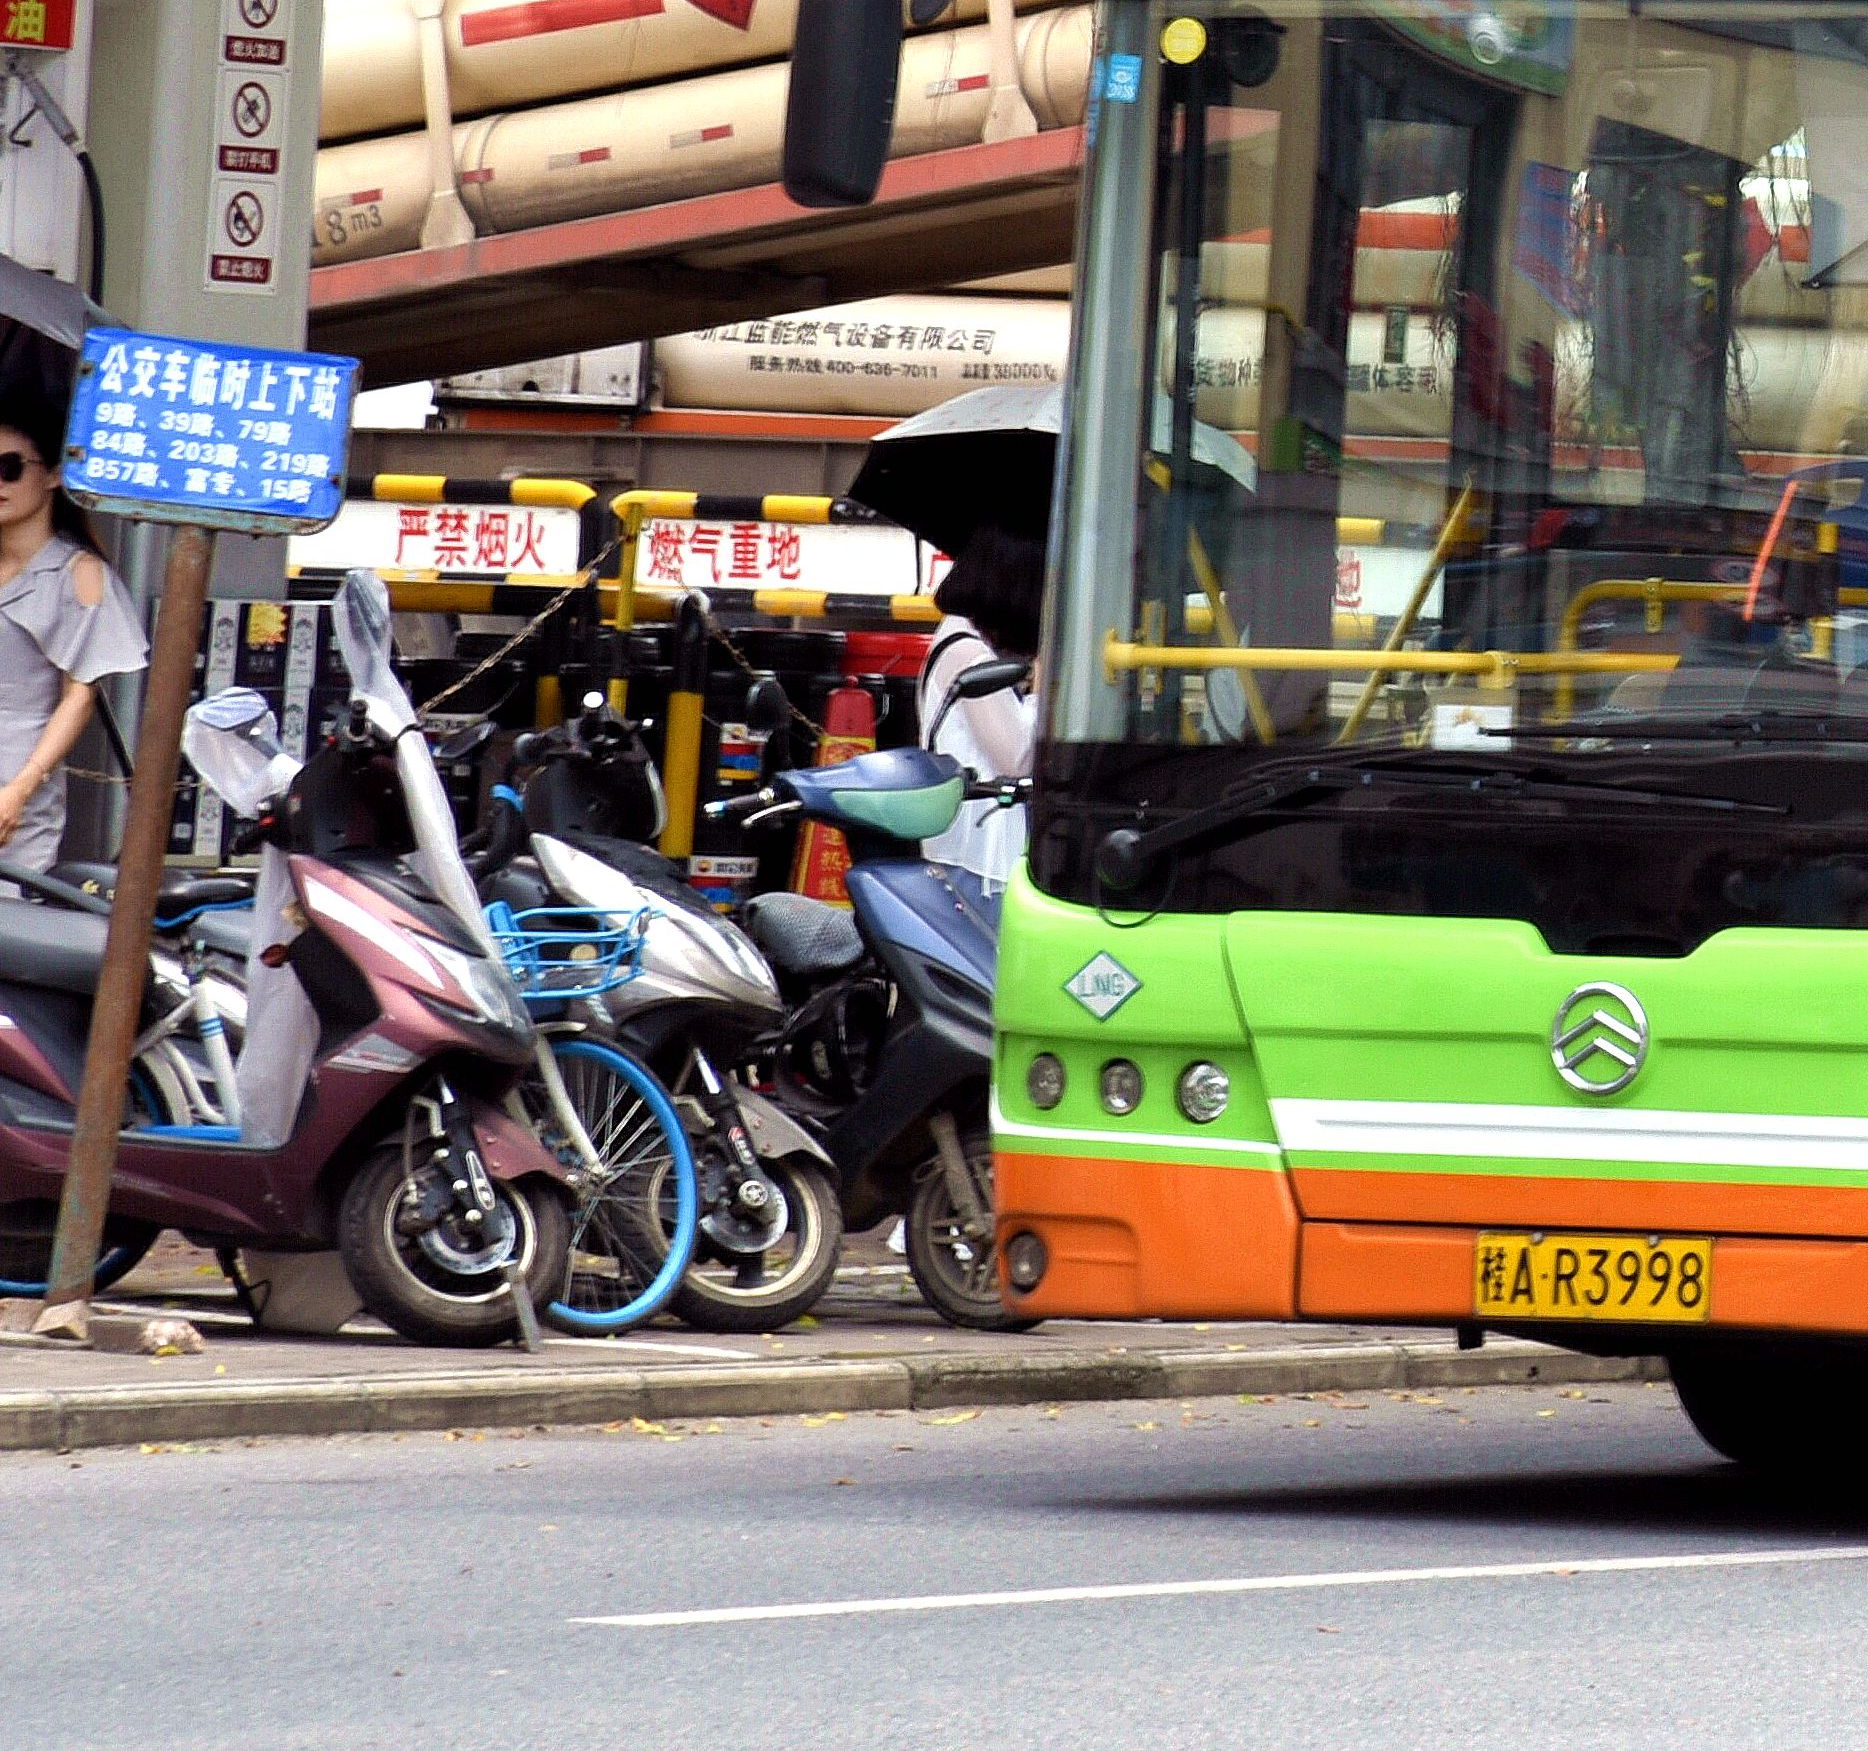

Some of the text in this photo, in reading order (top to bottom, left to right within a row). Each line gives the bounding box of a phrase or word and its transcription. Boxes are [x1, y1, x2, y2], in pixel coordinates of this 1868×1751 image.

[100, 344, 340, 420] 公交车临时上下站
[395, 507, 547, 569] 严禁烟火
[647, 521, 801, 584] 燃气重地
[1078, 973, 1124, 998] LNG
[1481, 1246, 1704, 1308] 桂A·R3998
